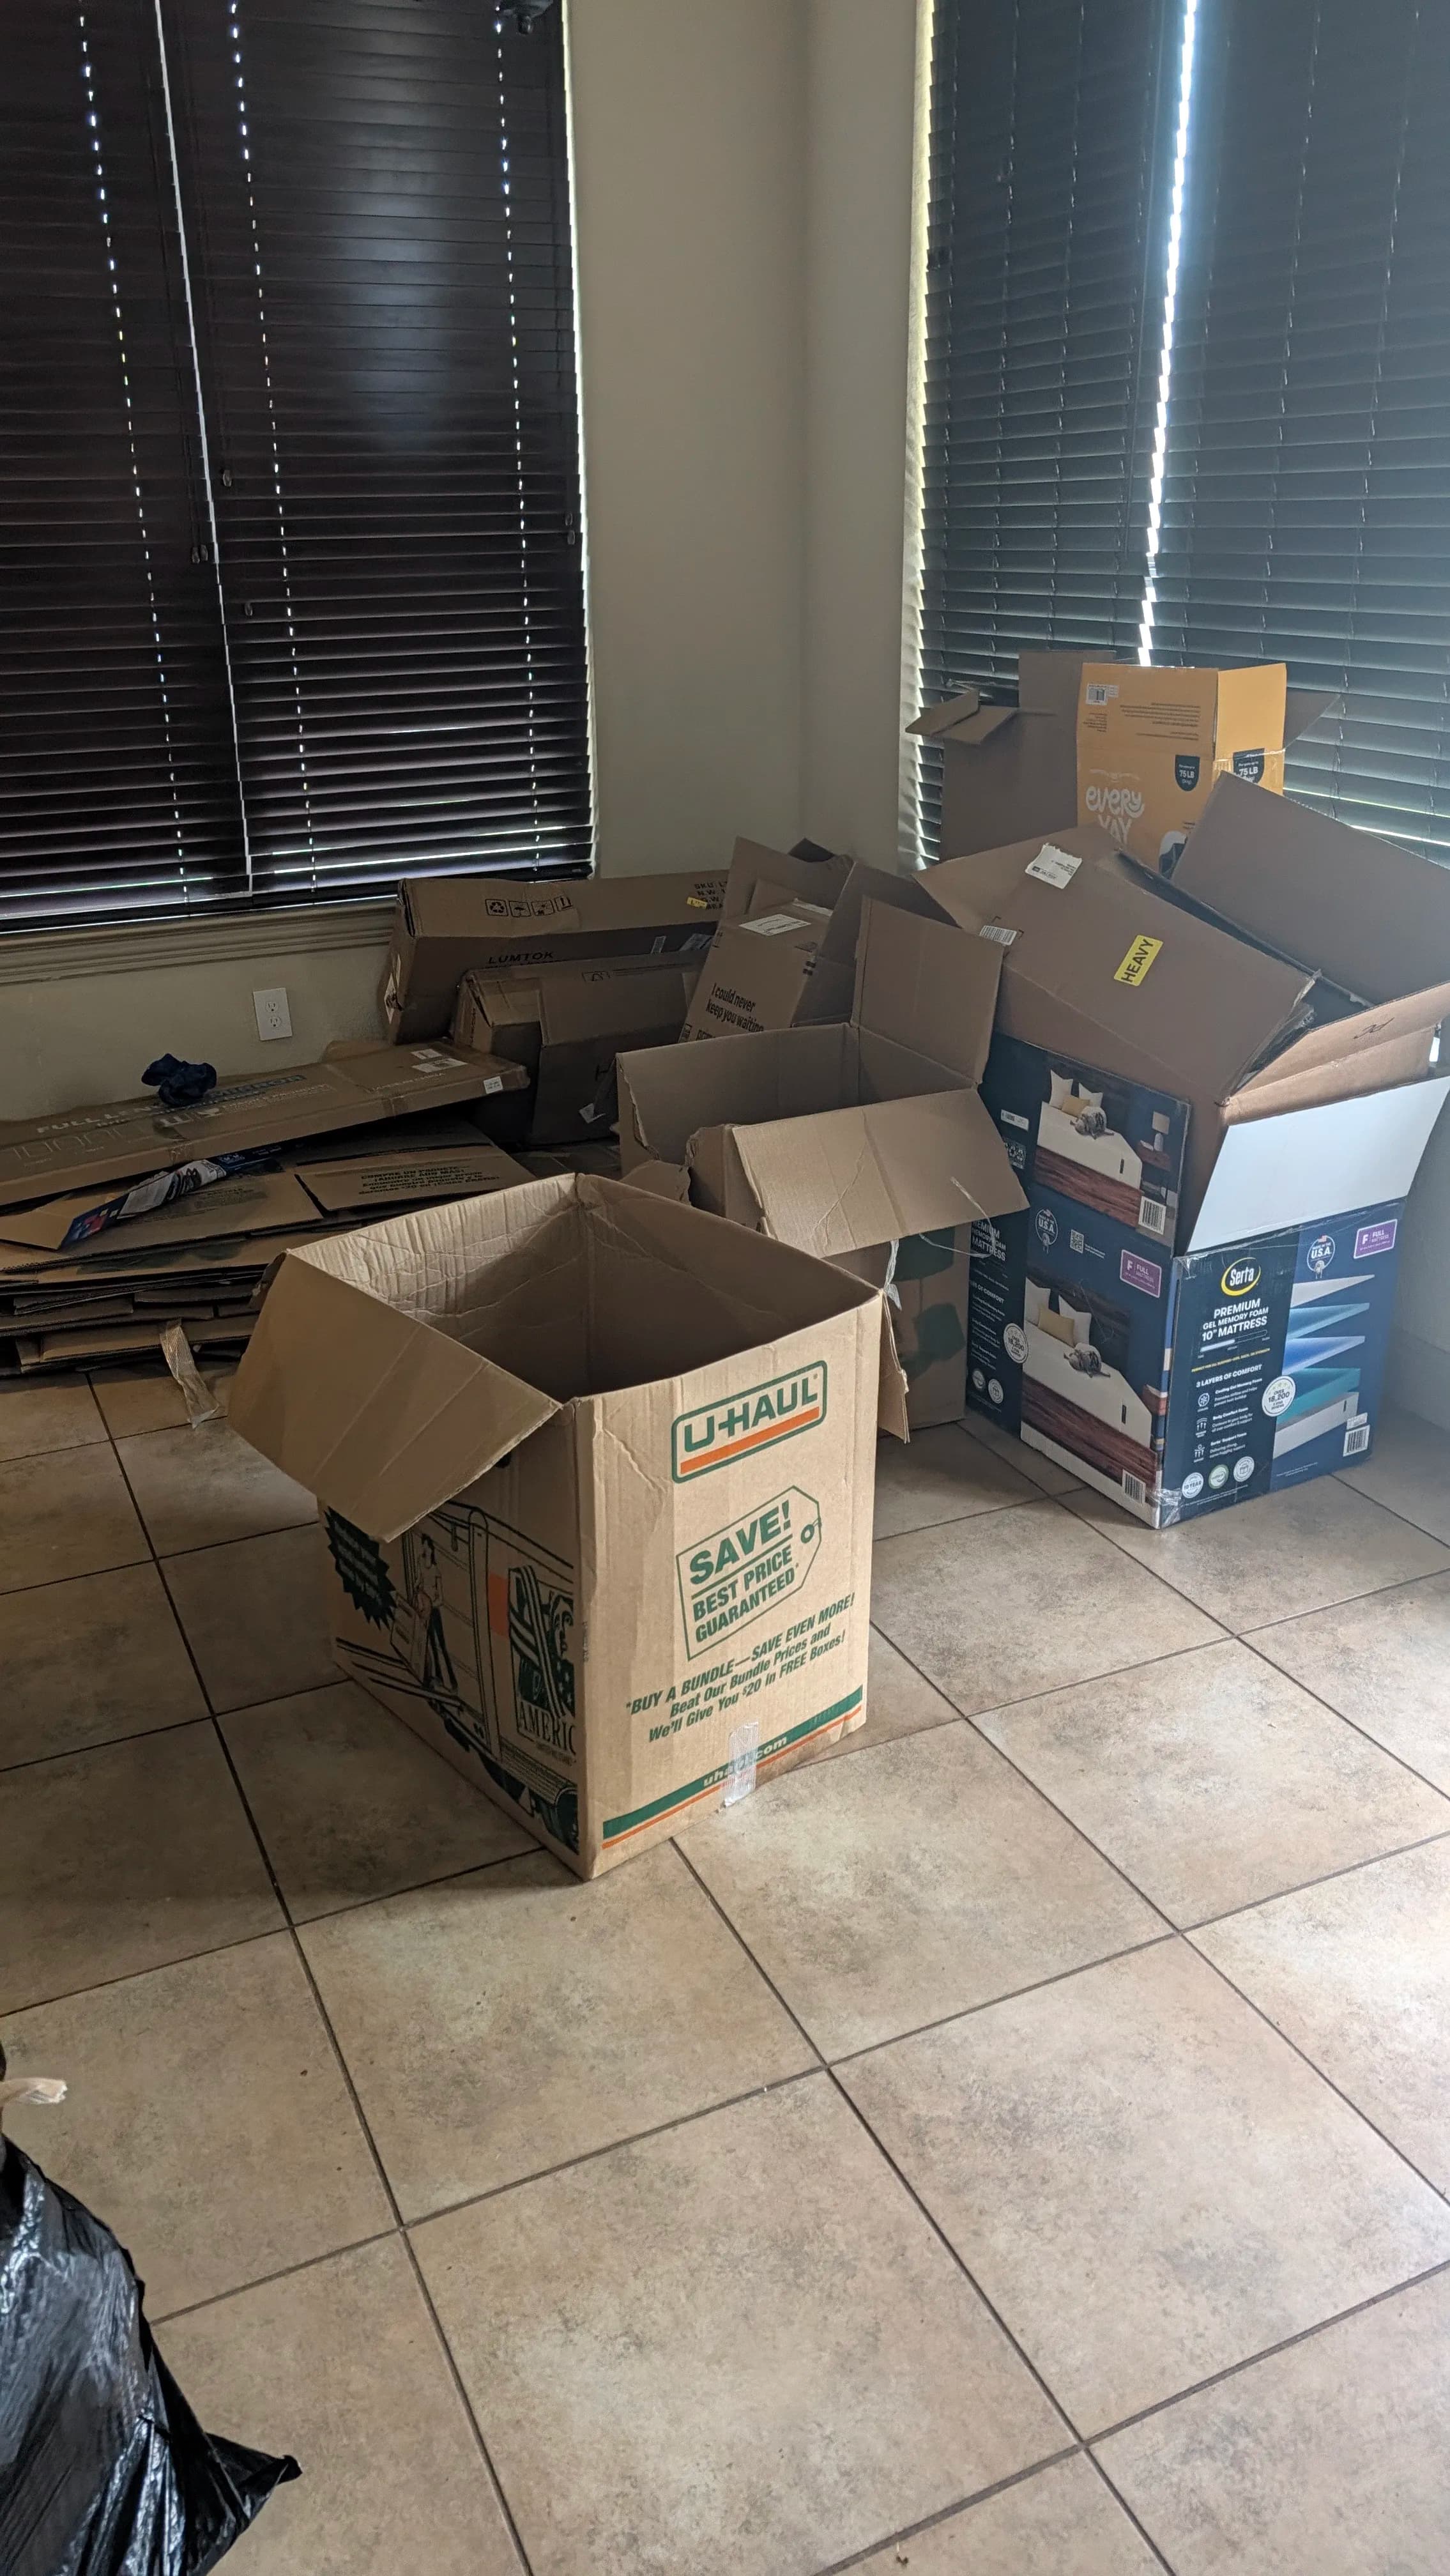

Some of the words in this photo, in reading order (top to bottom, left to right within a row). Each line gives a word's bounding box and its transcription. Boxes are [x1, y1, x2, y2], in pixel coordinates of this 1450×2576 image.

[488, 951, 554, 964] LUMTOK
[1120, 938, 1154, 983] HEAVY
[712, 982, 717, 995] I
[715, 987, 736, 1004] could
[734, 995, 756, 1013] never
[706, 999, 724, 1020] keep
[721, 1009, 737, 1023] you
[1362, 1234, 1369, 1245] F
[1230, 1266, 1255, 1286] Serta
[1203, 1321, 1216, 1330] GEL
[1217, 1312, 1248, 1326] MEMORY
[1249, 1307, 1269, 1318] FOAM
[1214, 1298, 1260, 1319] PREMIUM
[1218, 1315, 1267, 1338] MATTRESS
[1202, 1375, 1223, 1386] LAYERS
[1232, 1364, 1262, 1377] COMFORT
[1268, 1392, 1290, 1402] 18,200
[684, 1377, 818, 1452] U-HAUL
[1189, 1480, 1202, 1489] YEAR
[690, 1499, 791, 1584] SAVE!
[693, 1579, 738, 1622] BEST
[744, 1544, 793, 1591] PRICE
[665, 1686, 676, 1703] A
[786, 1614, 816, 1643] EVEN
[818, 1591, 855, 1625] MORE!
[670, 1694, 701, 1718] Beat
[704, 1683, 727, 1703] Our
[729, 1660, 771, 1690] Bundle
[773, 1638, 807, 1666] Prices
[810, 1622, 831, 1645] and
[649, 1717, 683, 1743] We'll
[686, 1705, 714, 1727] Give
[718, 1693, 739, 1712] You
[742, 1678, 762, 1698] $20
[765, 1672, 776, 1687] in
[779, 1652, 807, 1678] FREE
[809, 1629, 846, 1660] Boxes!
